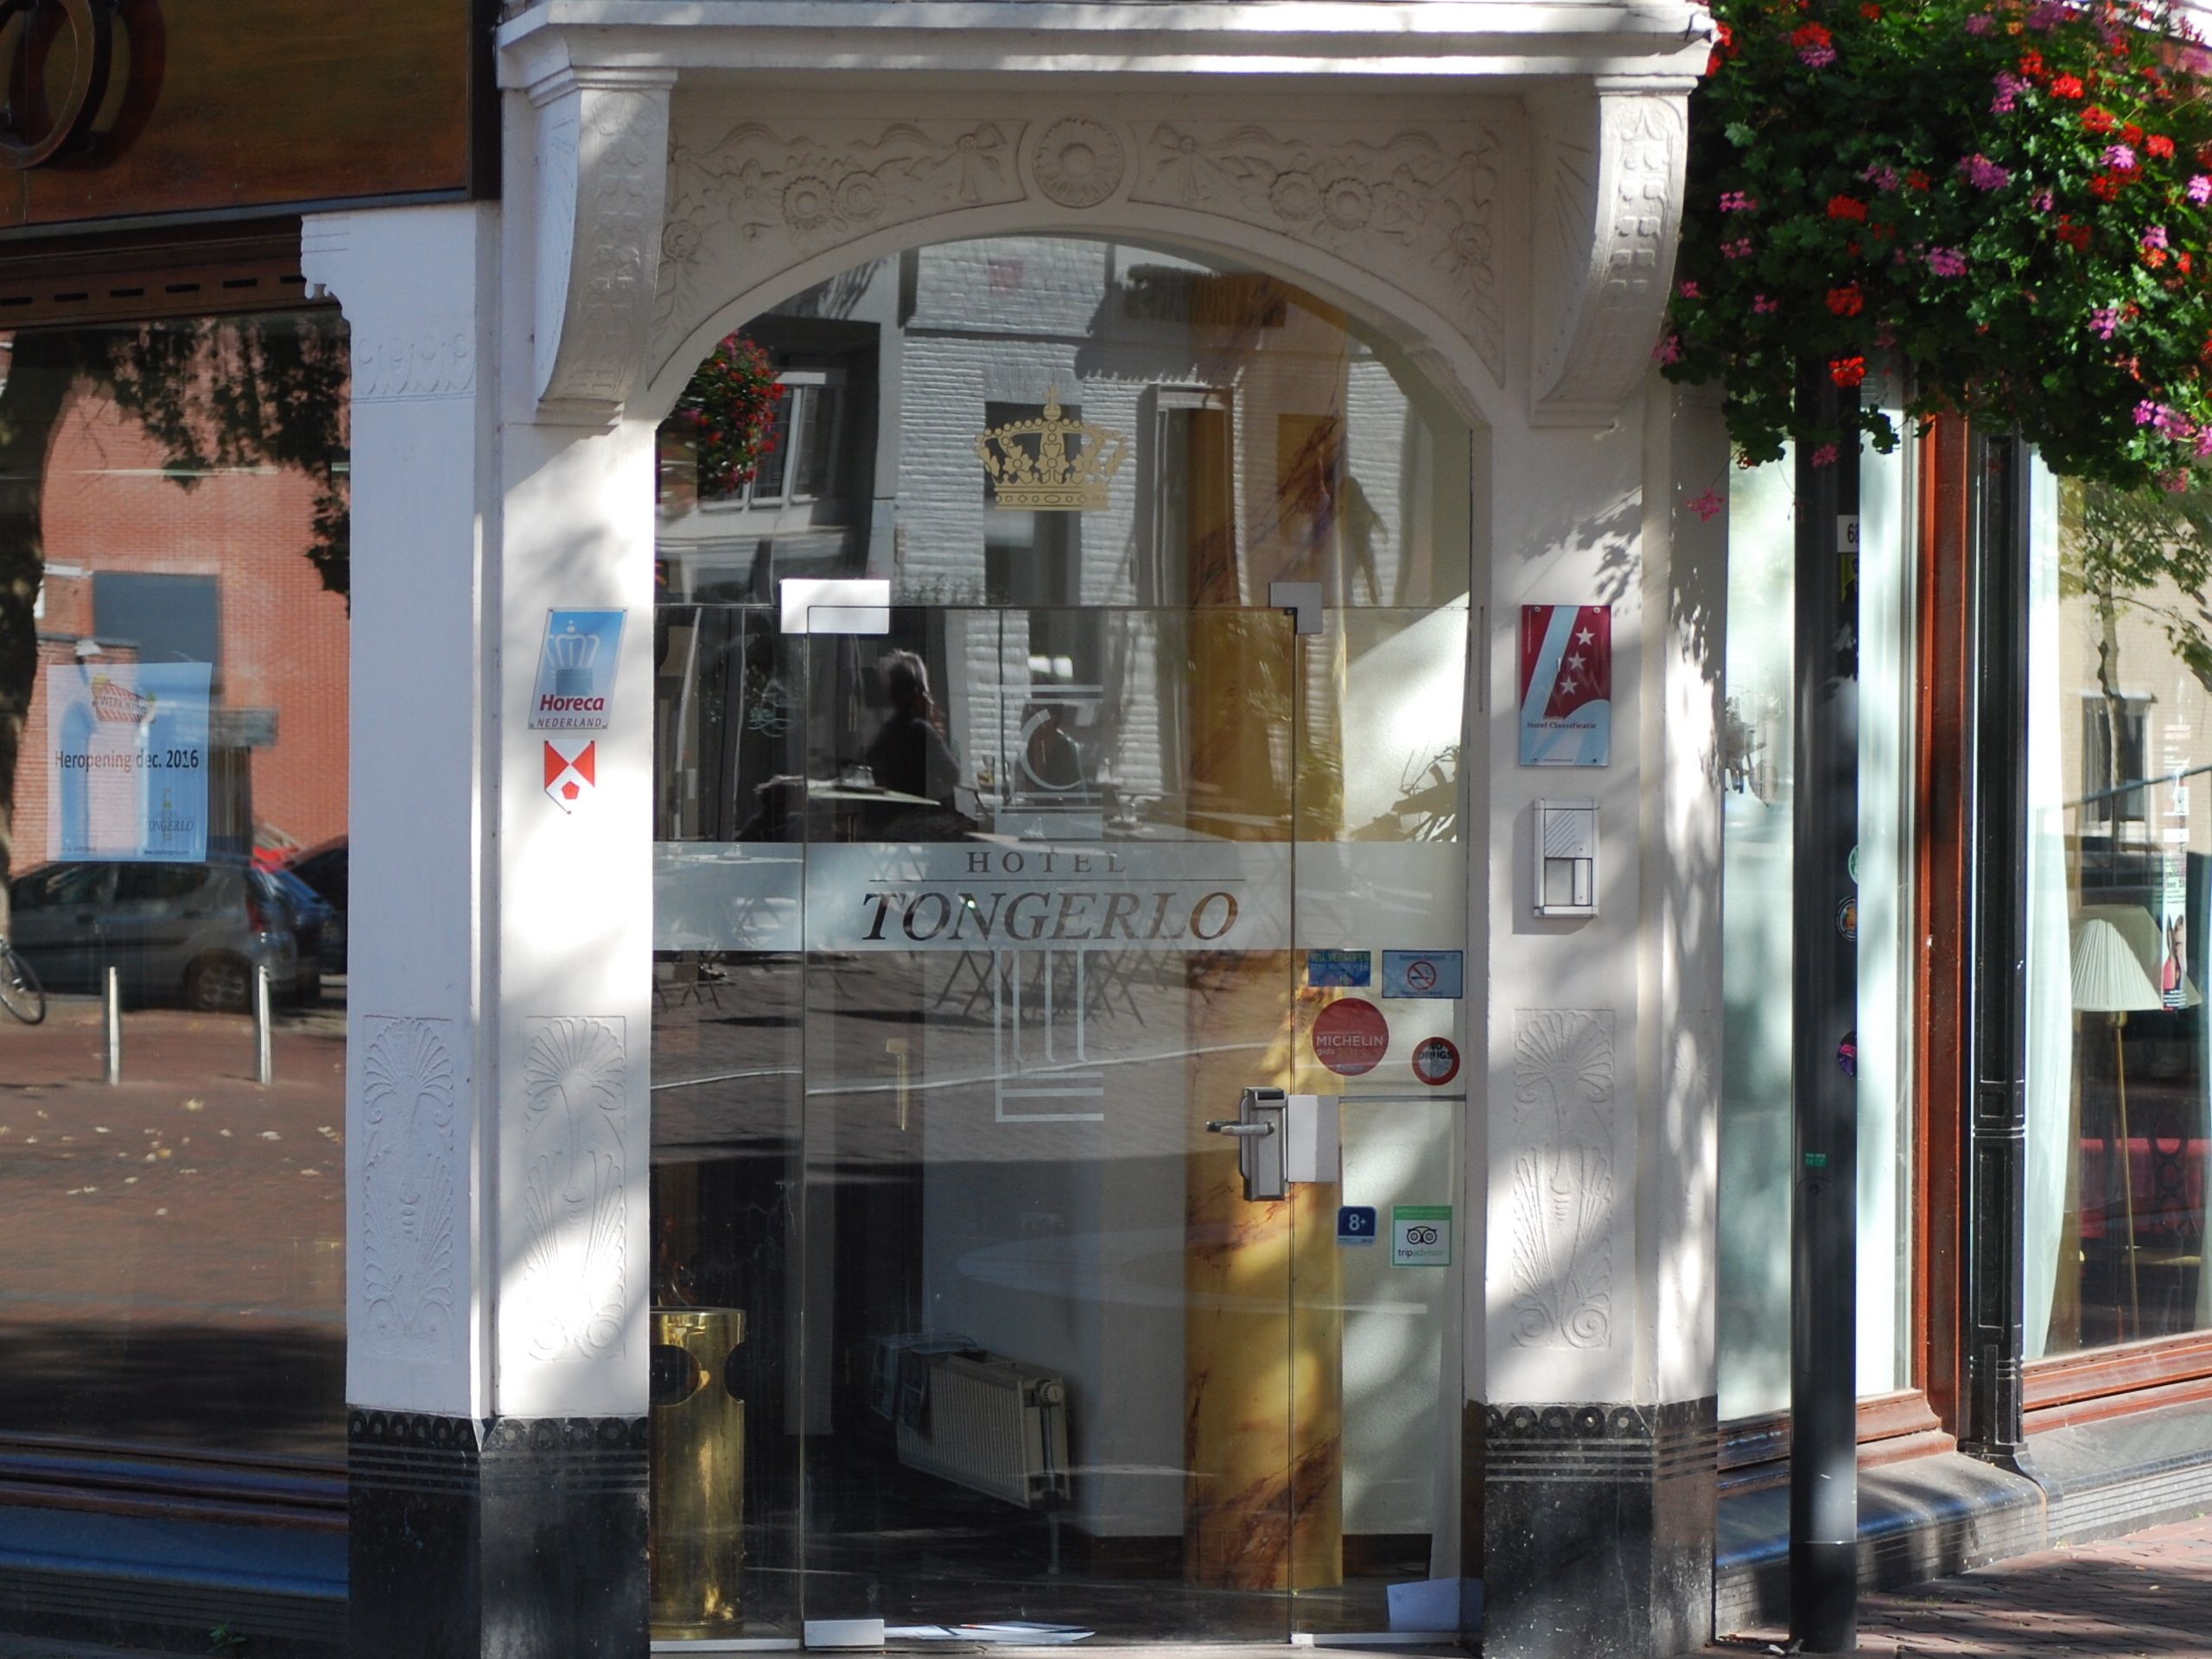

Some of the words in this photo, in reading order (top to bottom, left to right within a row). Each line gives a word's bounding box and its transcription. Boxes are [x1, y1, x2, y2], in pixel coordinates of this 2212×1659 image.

[539, 694, 604, 711] Horeca
[537, 718, 601, 727] NEDERLAND
[55, 749, 131, 772] Heropening
[137, 748, 162, 768] dec.
[166, 749, 199, 768] 2016
[147, 819, 194, 832] ONGERLO
[966, 851, 1127, 874] HOTEL
[861, 890, 1239, 942] TONGERLO
[1316, 1035, 1383, 1046] MICHELIN
[1428, 1041, 1443, 1051] NO
[1317, 1047, 1335, 1057] gids
[1418, 1051, 1454, 1060] DRUGS
[1397, 1248, 1445, 1258] tripadvisor
